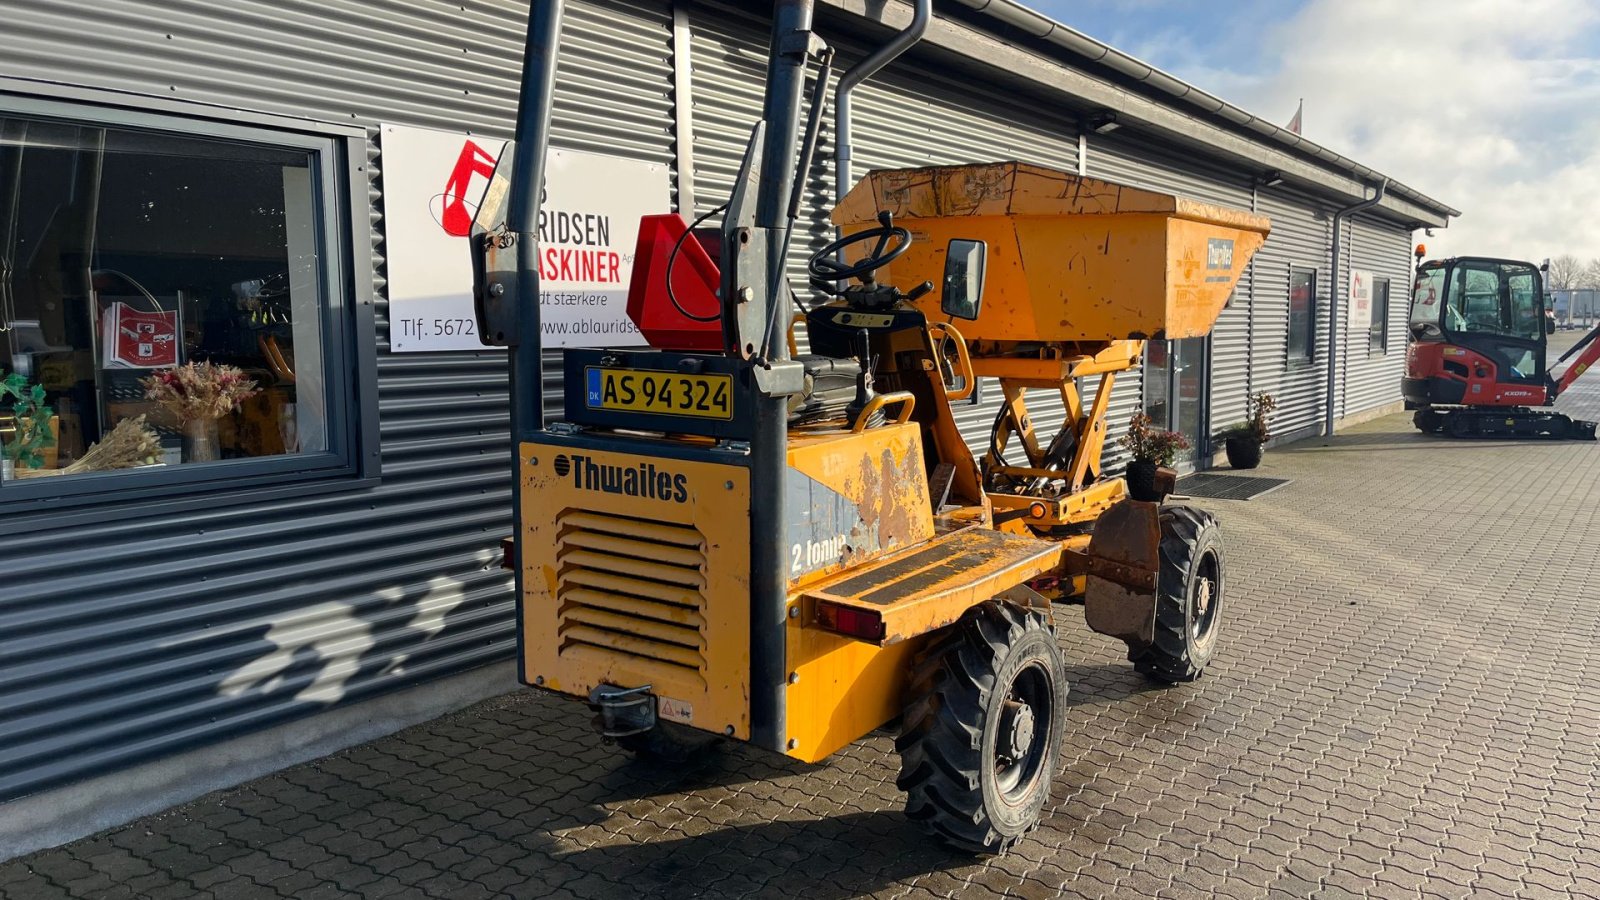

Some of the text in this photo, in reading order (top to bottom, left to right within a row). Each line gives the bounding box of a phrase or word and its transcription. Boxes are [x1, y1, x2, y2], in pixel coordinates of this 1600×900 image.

[538, 209, 610, 247] RIDSEN
[538, 248, 620, 283] ASKINER
[539, 291, 608, 306] dt stærkere
[400, 318, 640, 341] Tlf. 5672 ww.ablauridse
[589, 391, 599, 400] DK
[603, 374, 727, 412] AS 94 324
[571, 454, 688, 503] Thwaites
[792, 534, 846, 573] 2 tonne
